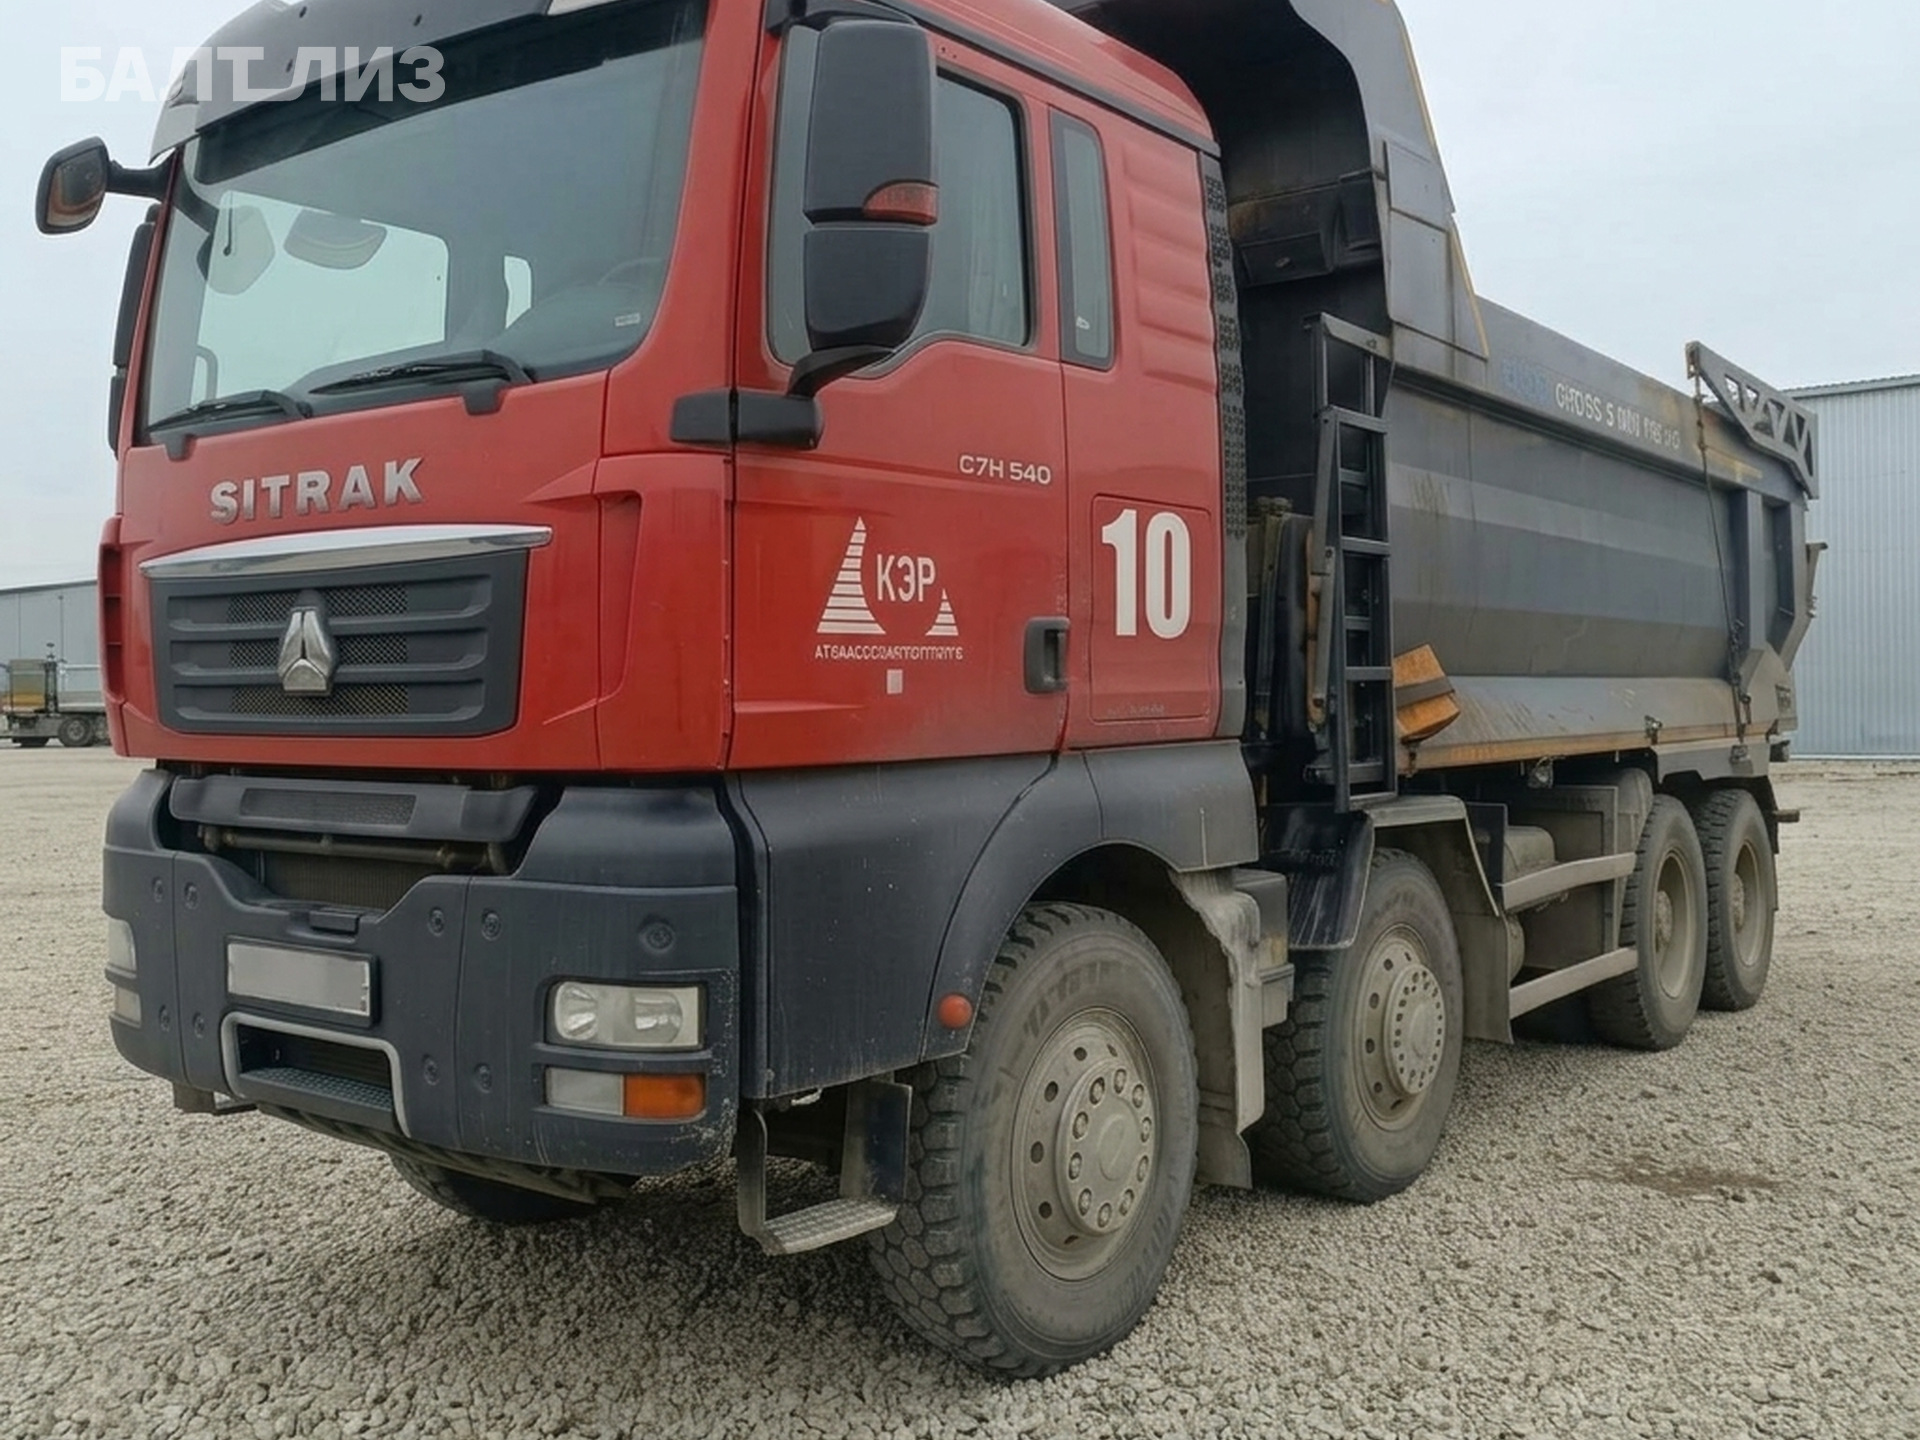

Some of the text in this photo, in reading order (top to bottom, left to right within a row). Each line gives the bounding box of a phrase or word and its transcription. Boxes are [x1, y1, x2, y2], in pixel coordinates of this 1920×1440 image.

[210, 456, 424, 525] SITRAK
[958, 454, 1052, 486] C7H 540
[876, 553, 936, 603] КЭР
[1101, 508, 1192, 640] 10
